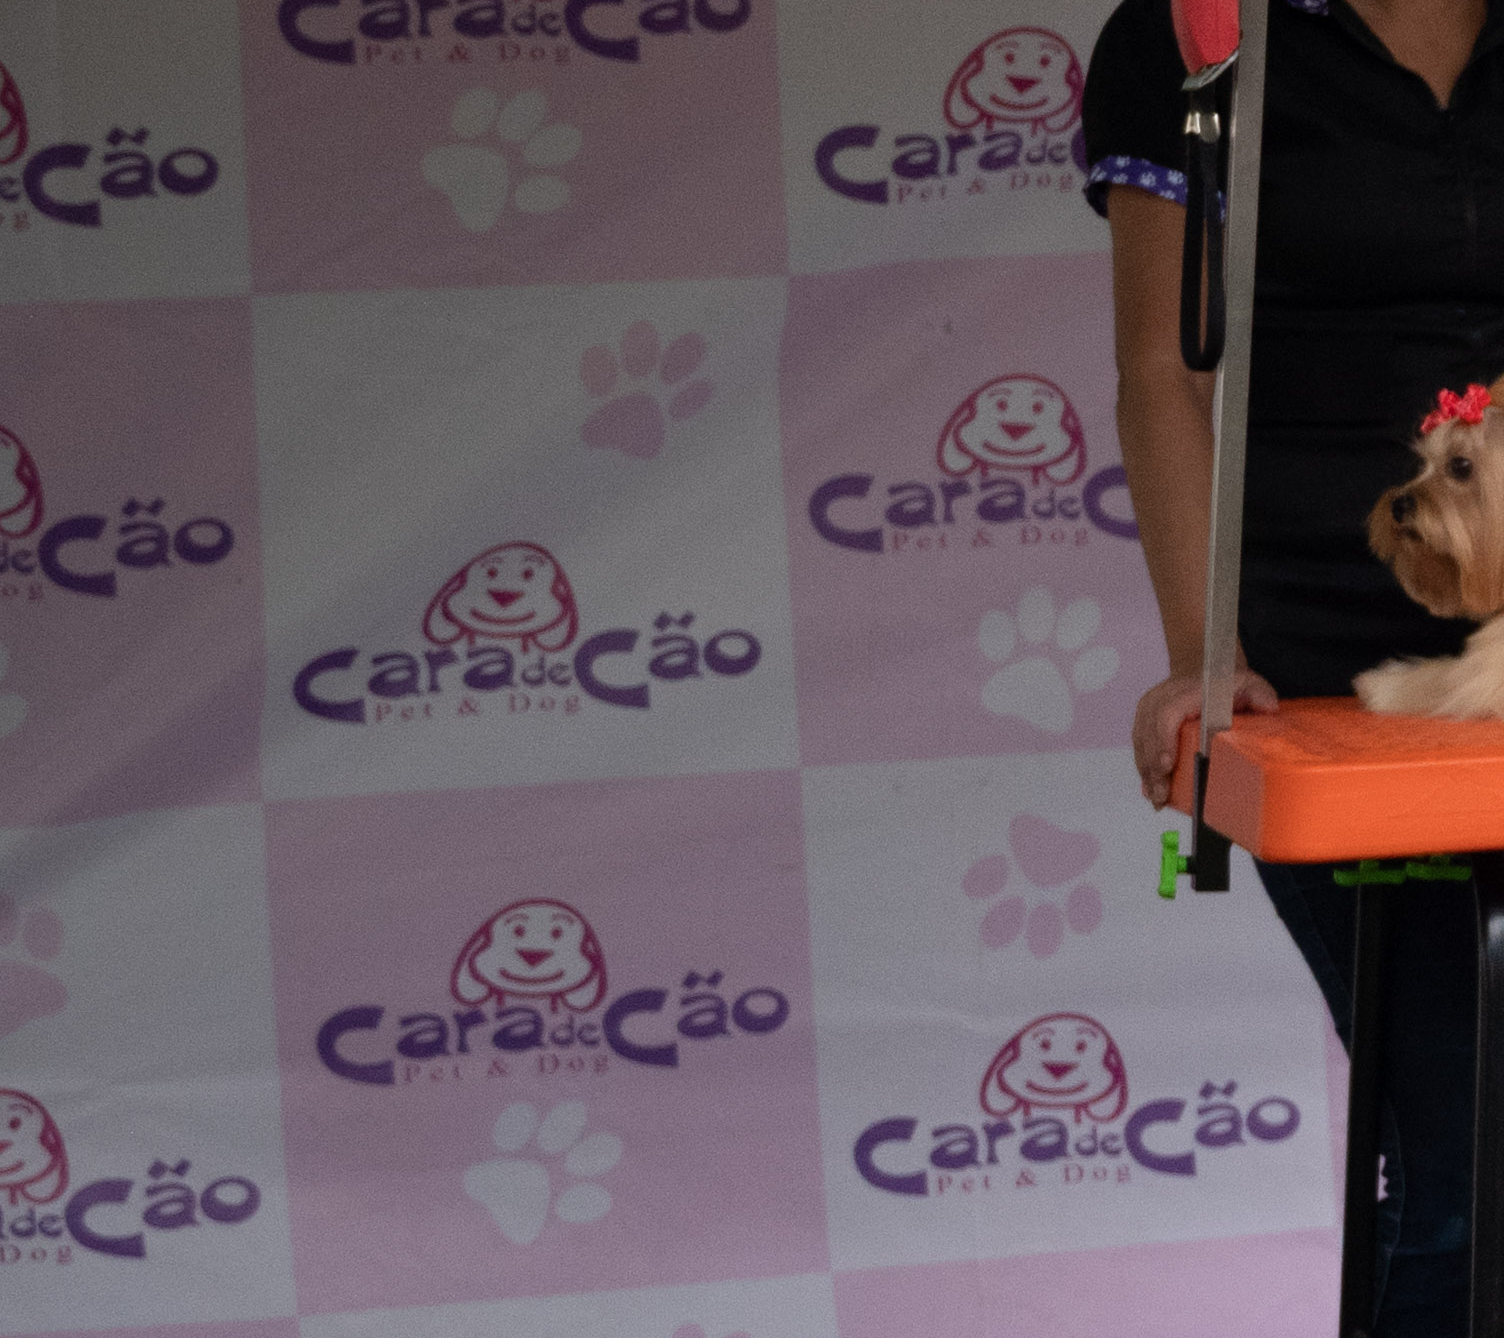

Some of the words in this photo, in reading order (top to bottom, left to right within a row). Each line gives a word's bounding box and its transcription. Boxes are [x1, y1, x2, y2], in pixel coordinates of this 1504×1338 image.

[510, 3, 563, 37] de
[363, 43, 424, 65] Pet
[497, 42, 573, 67] Dog
[814, 123, 1018, 207] Cara
[1021, 134, 1068, 166] de
[894, 179, 947, 203] Pet
[1009, 170, 1077, 192] Dog
[809, 474, 1028, 554] Cara
[1031, 487, 1082, 519] de
[891, 529, 949, 552] Pet
[1018, 524, 1092, 546] Dog
[288, 644, 516, 725] Cara
[520, 656, 572, 688] de
[373, 699, 434, 722] Pet
[506, 693, 583, 715] Dog
[315, 1004, 546, 1087] Cara
[549, 1015, 602, 1048] de
[402, 1060, 463, 1083] Pet
[536, 1052, 612, 1075] Dog
[853, 1115, 1070, 1197] Cara
[1074, 1126, 1124, 1158] de
[935, 1170, 993, 1193] Pet
[1061, 1162, 1133, 1184] Dog
[9, 1207, 64, 1239] de
